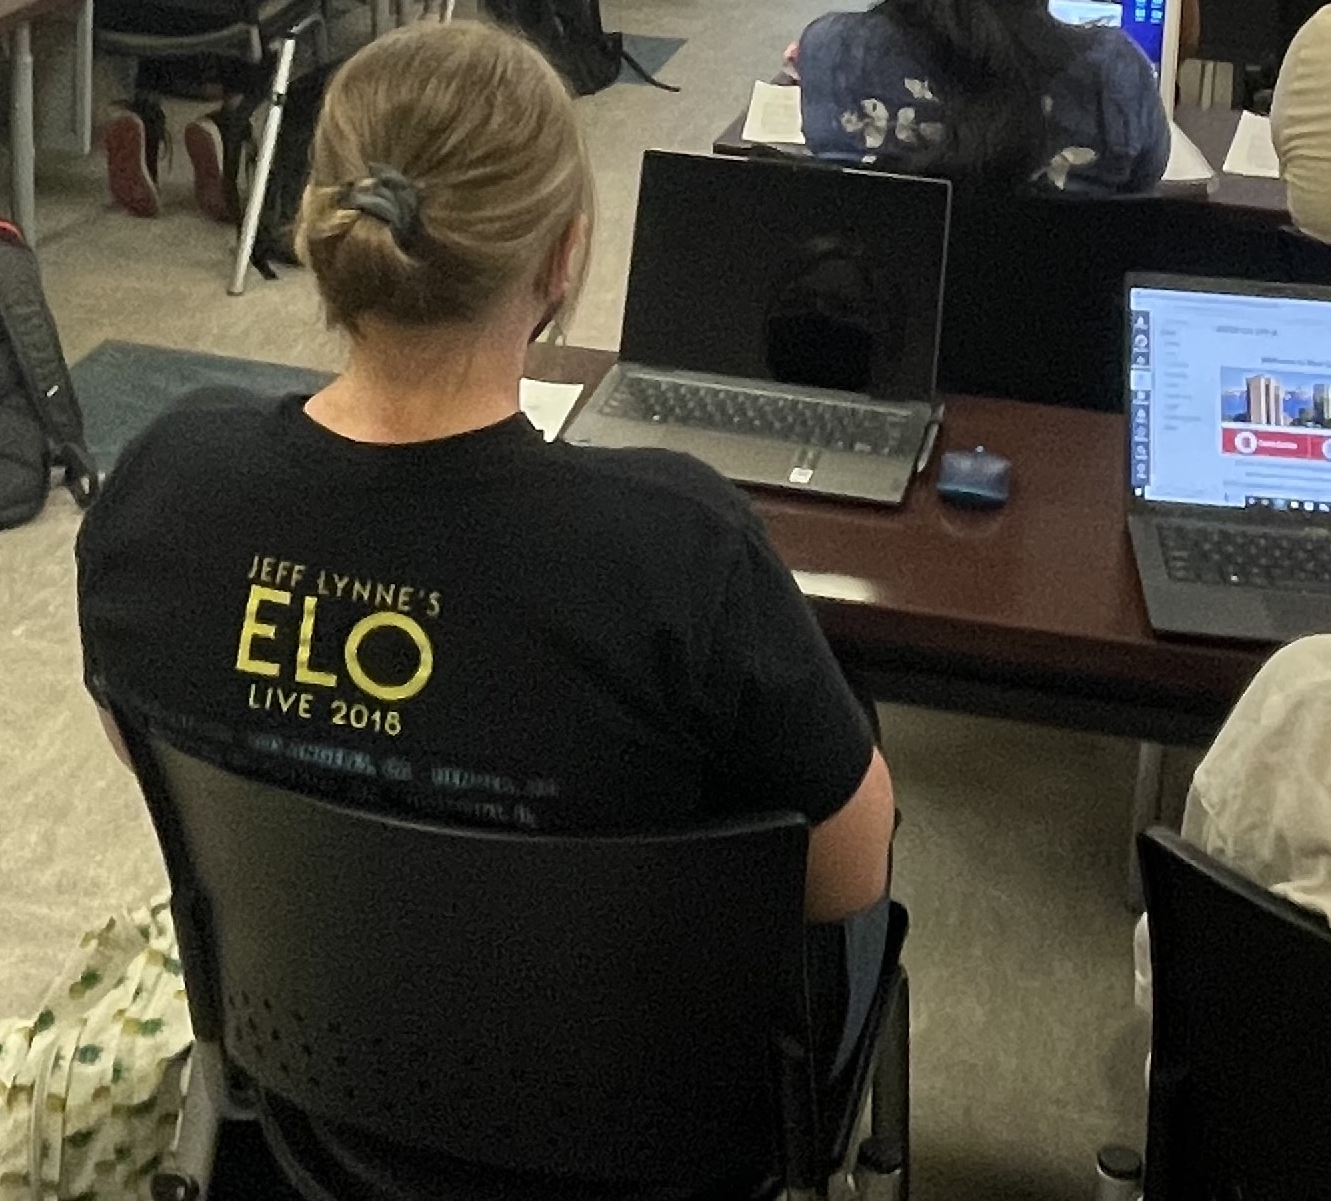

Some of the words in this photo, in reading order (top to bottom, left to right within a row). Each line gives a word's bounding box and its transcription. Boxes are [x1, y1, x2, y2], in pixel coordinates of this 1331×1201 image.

[247, 554, 307, 587] JEFF
[317, 569, 443, 618] LYNNE'S
[235, 584, 435, 701] ELO
[248, 684, 314, 719] LIVE
[330, 700, 403, 737] 2018
